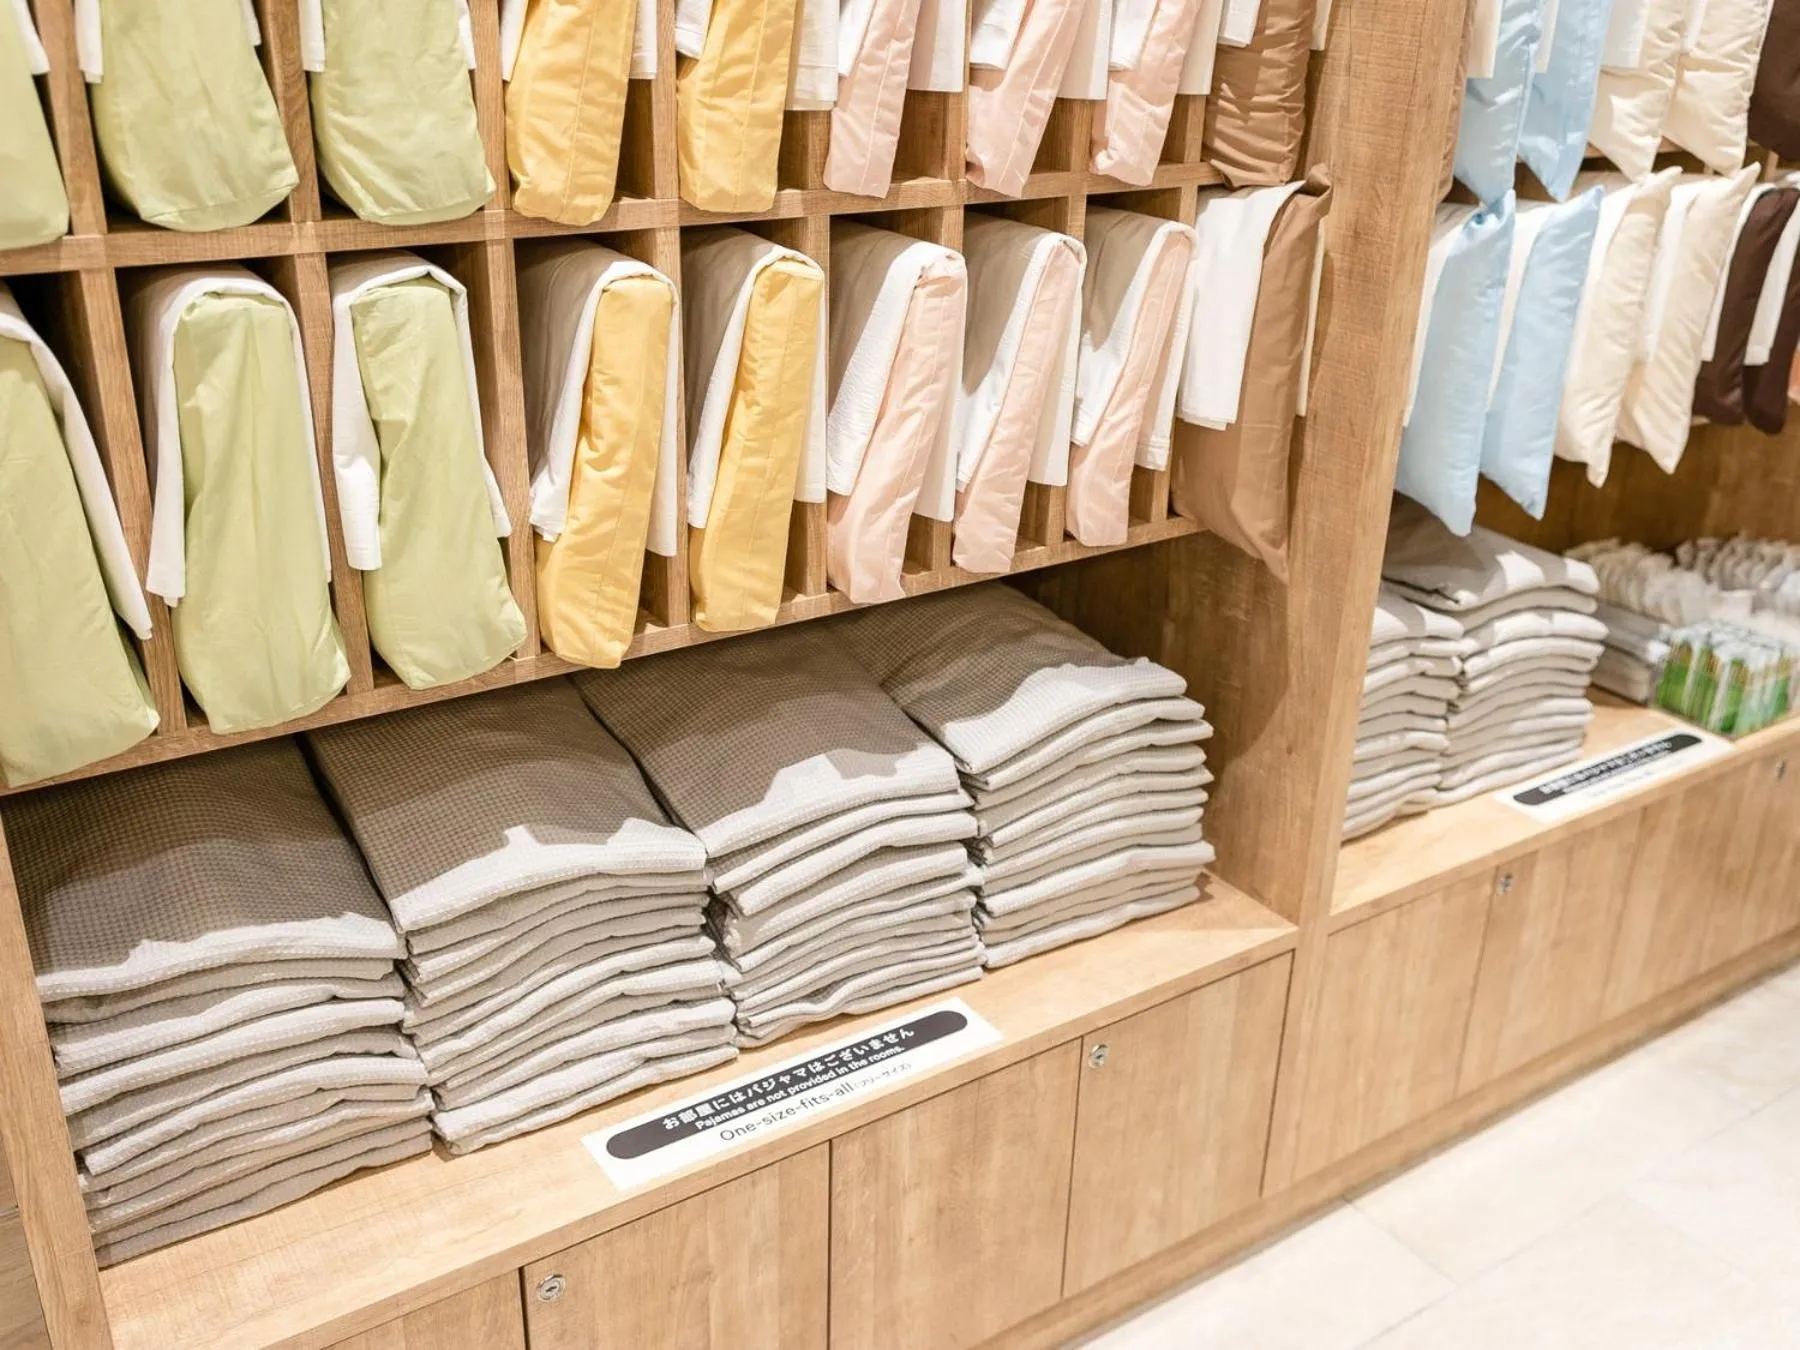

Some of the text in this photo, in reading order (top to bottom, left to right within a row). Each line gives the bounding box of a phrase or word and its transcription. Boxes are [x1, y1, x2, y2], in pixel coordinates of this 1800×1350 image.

[662, 1028, 915, 1130] お部屋にはパジャマはございません
[694, 1046, 905, 1130] Pajamas are not provided in the rooms.
[719, 1081, 855, 1141] One-size-fits-all
